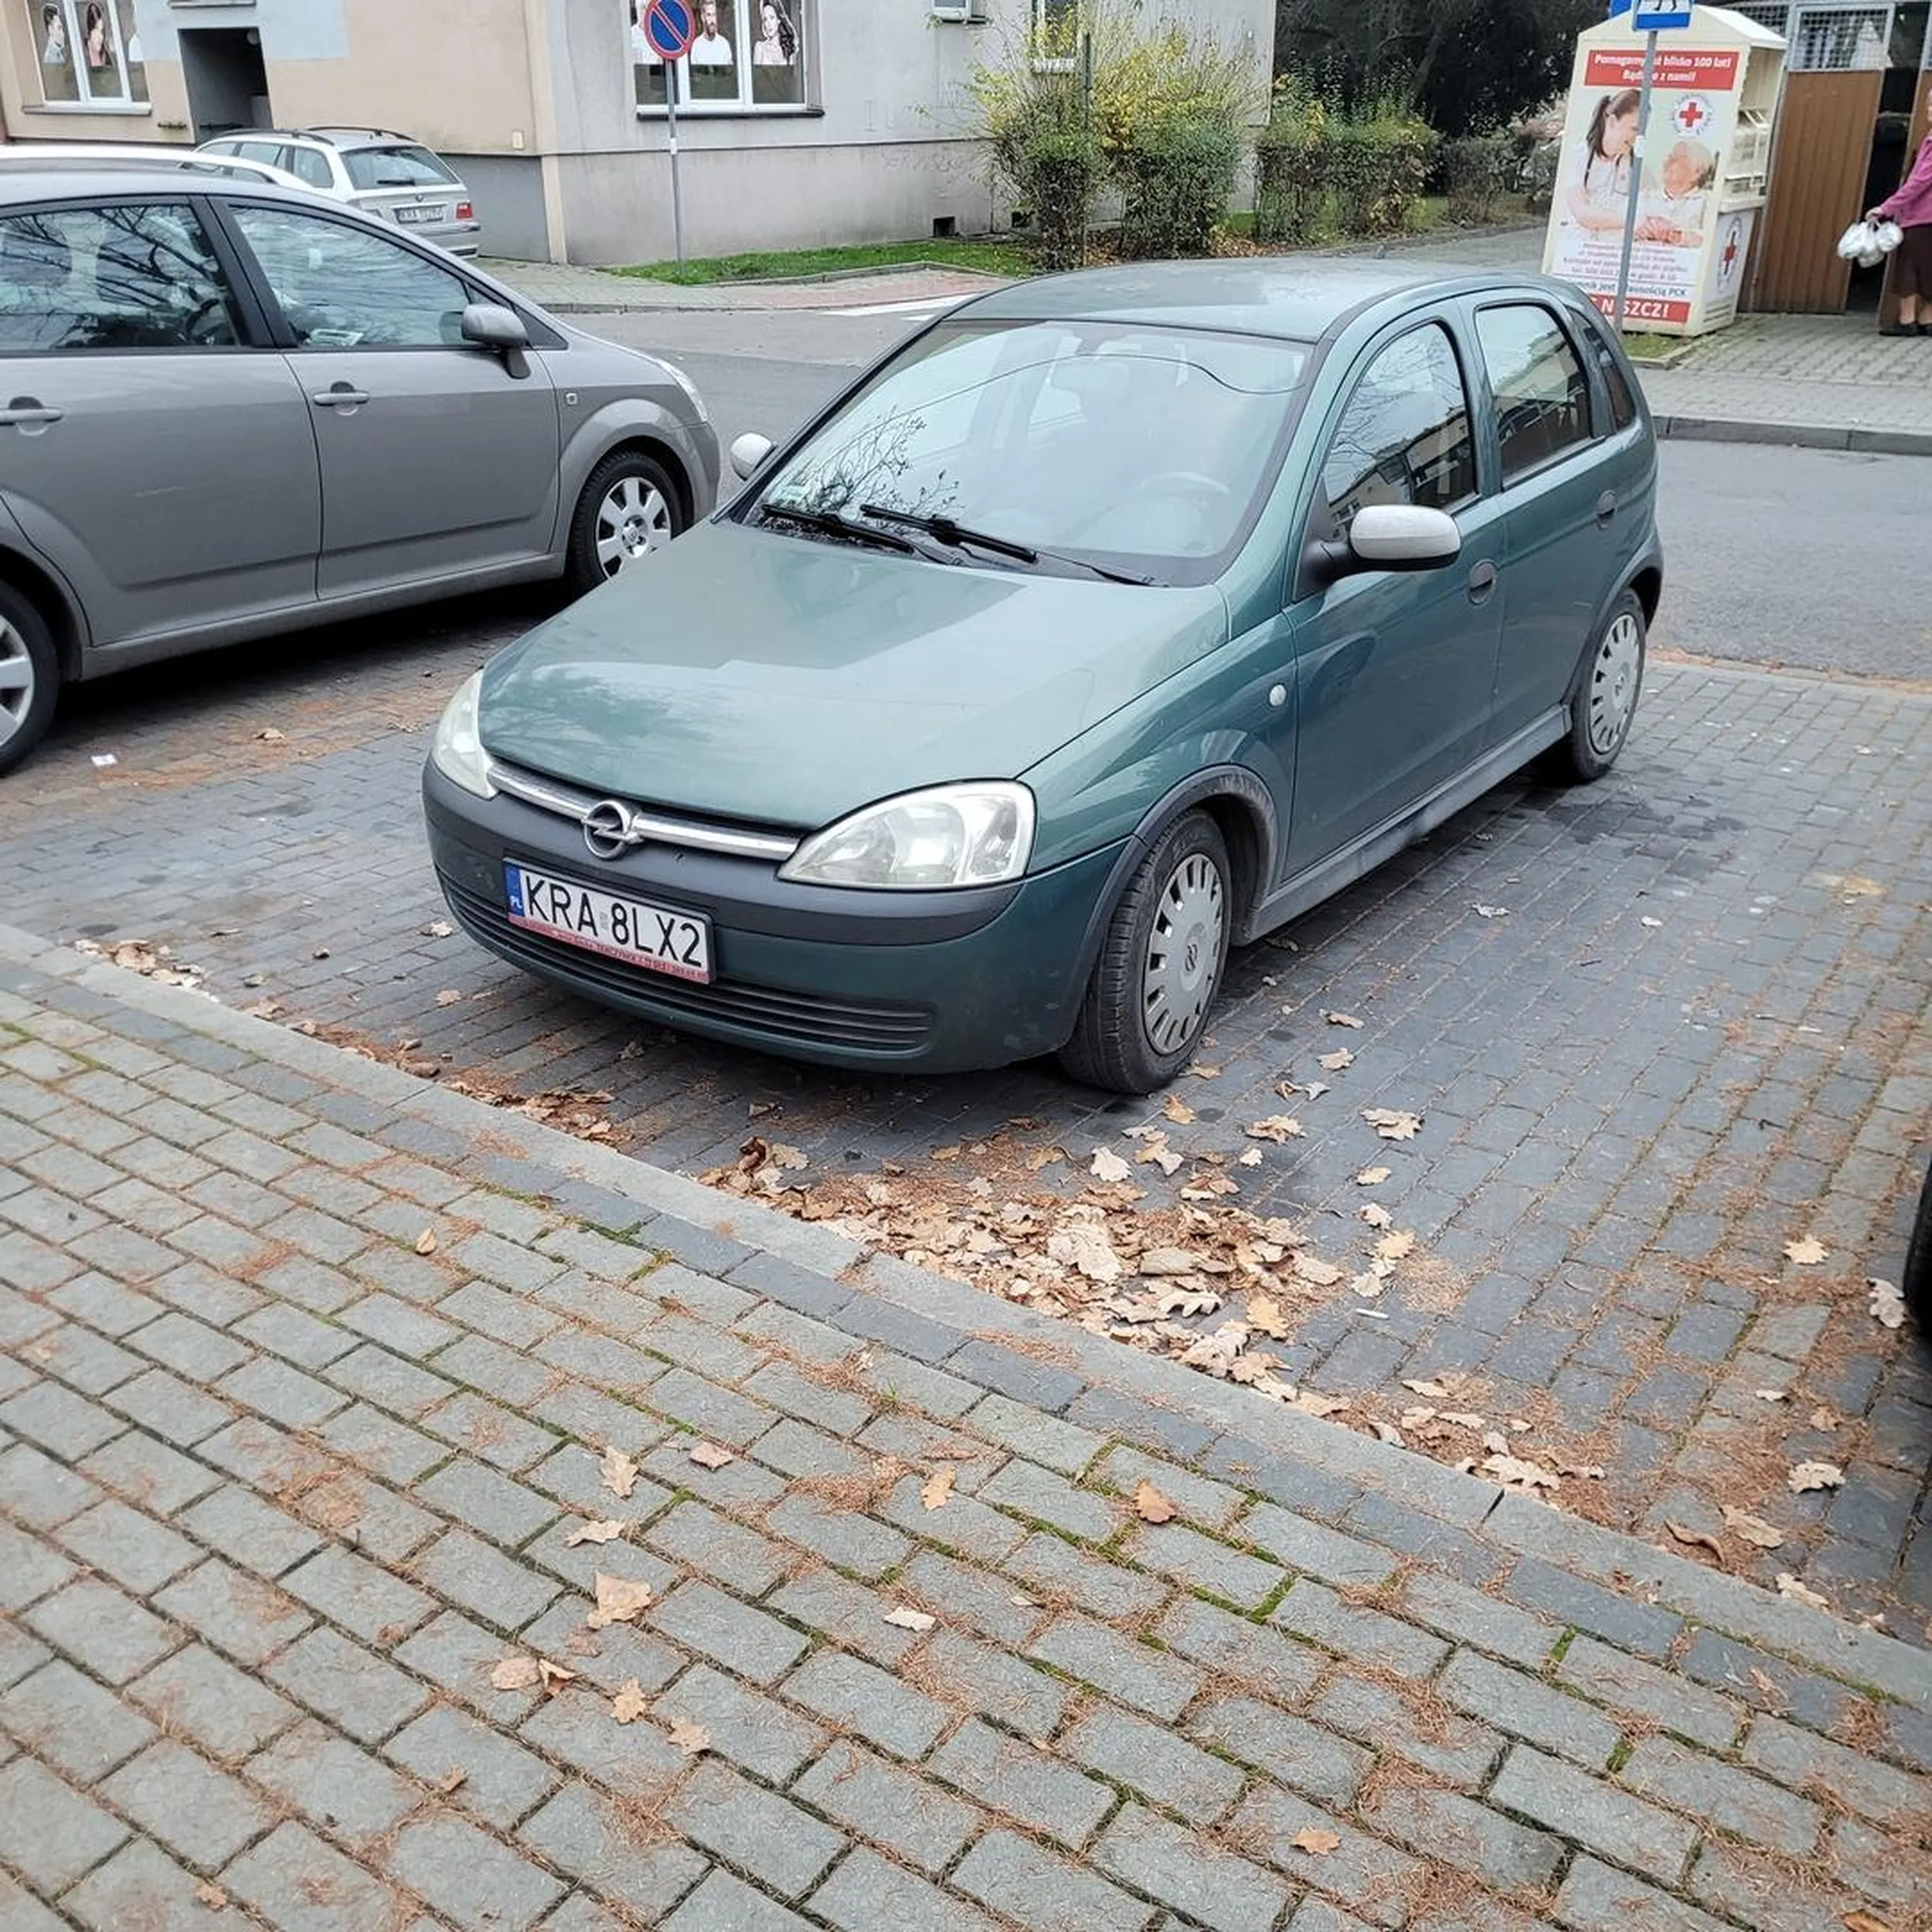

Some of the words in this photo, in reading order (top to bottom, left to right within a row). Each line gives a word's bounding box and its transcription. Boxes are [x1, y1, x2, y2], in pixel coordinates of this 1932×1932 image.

[1694, 56, 1713, 68] 100
[1600, 298, 1669, 318] NSZCZ!
[526, 875, 598, 937] KRA
[611, 903, 701, 968] 8LX2
